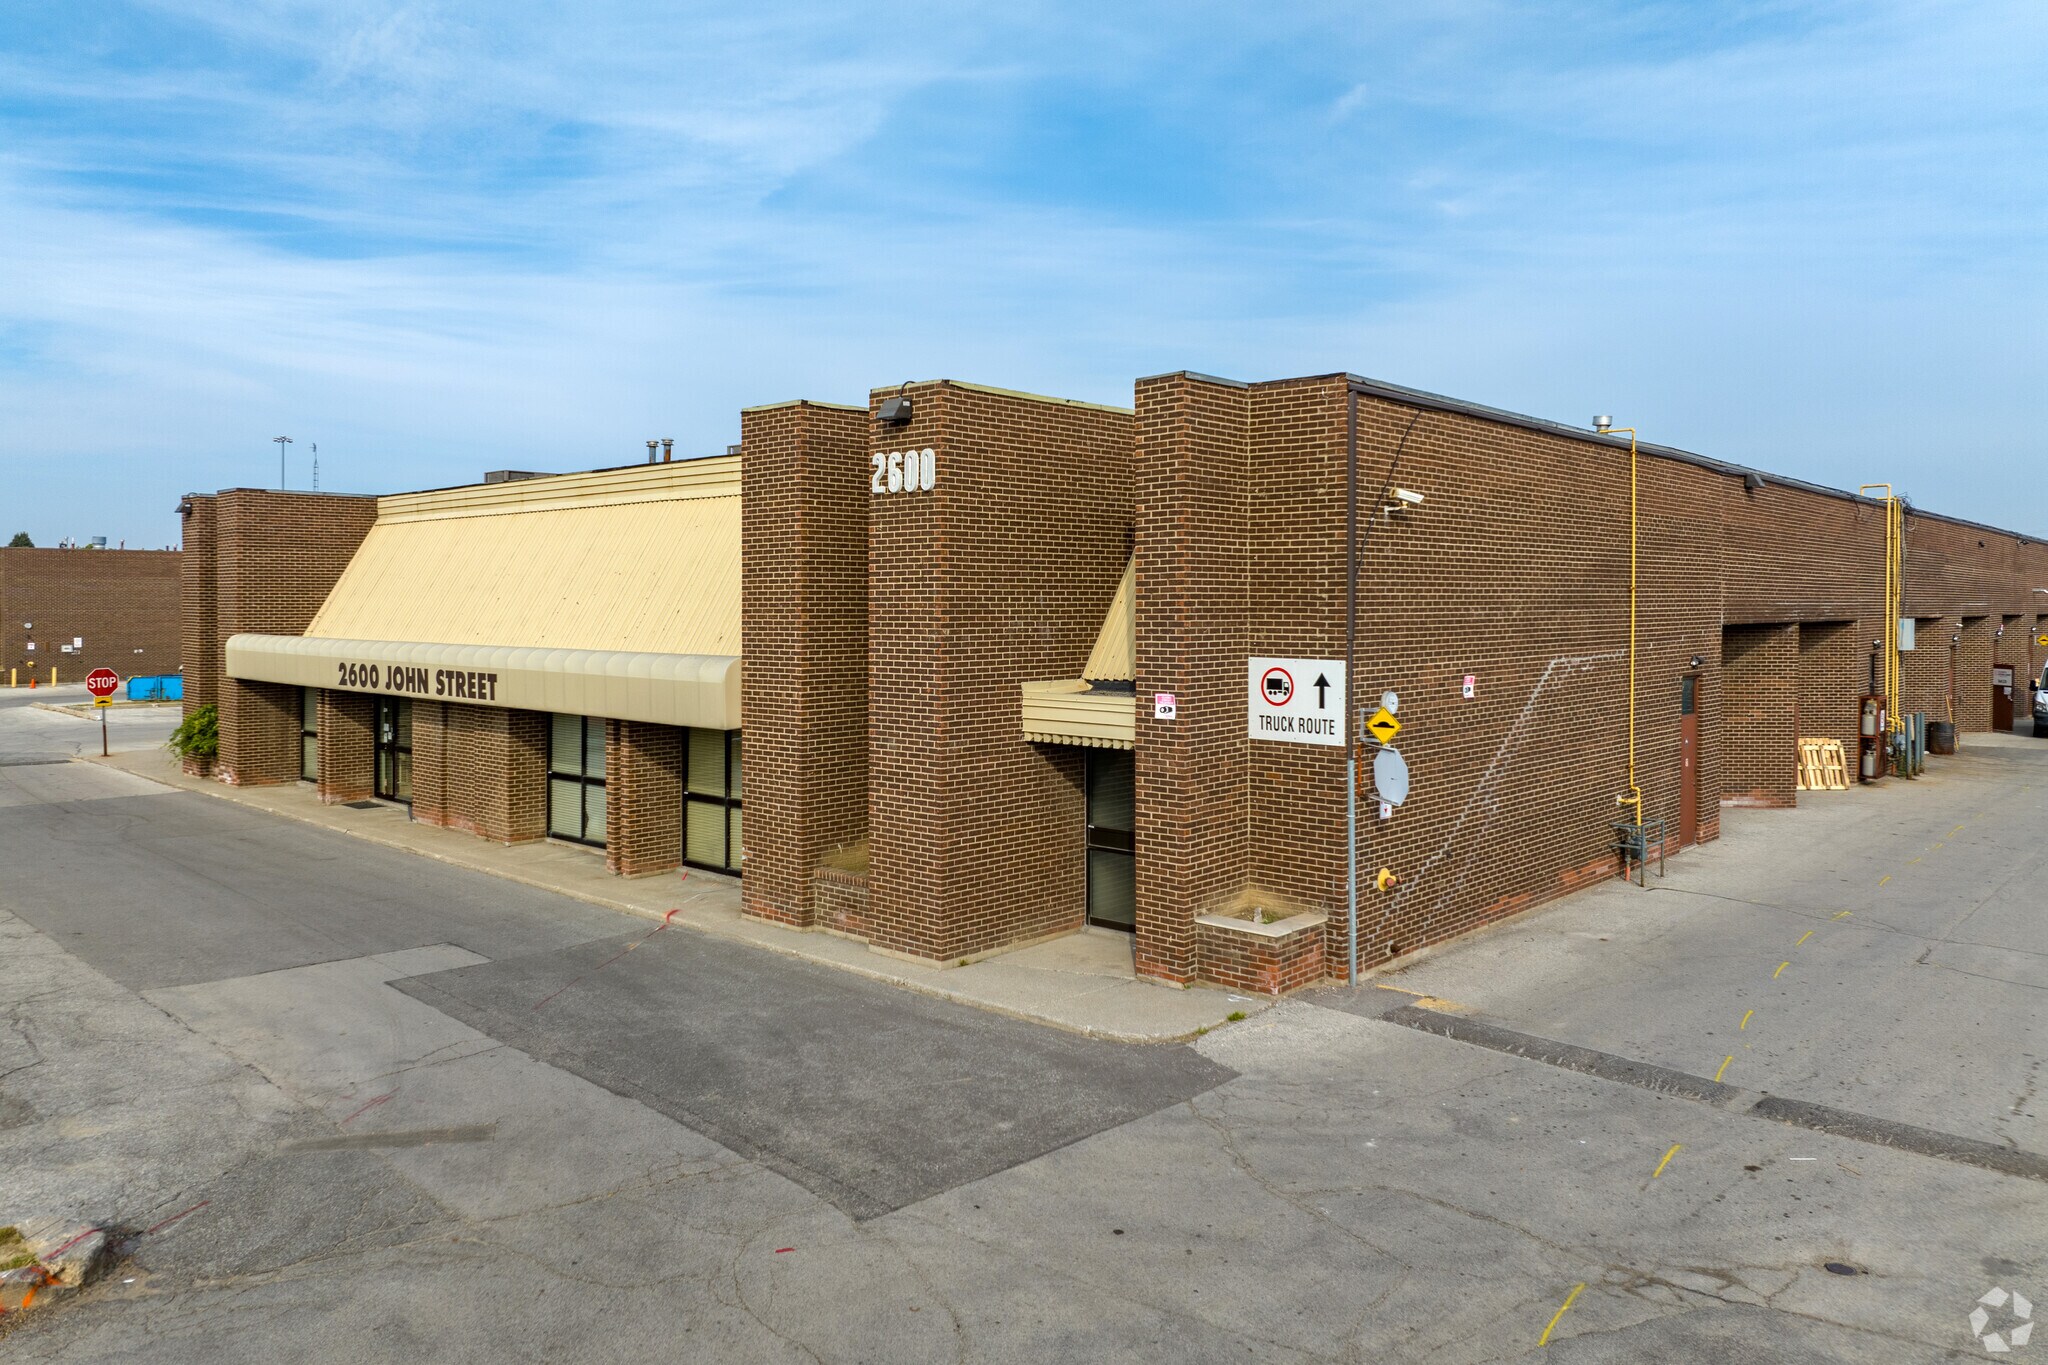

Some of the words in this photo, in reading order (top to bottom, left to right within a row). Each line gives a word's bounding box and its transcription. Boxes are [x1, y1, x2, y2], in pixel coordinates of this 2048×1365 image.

[872, 448, 936, 494] 2600
[88, 676, 117, 689] STOP
[338, 662, 380, 689] 2600
[385, 665, 429, 694] JOHN
[435, 669, 498, 701] STREET
[1259, 715, 1295, 733] TRUCK
[1298, 717, 1335, 736] ROUTE
